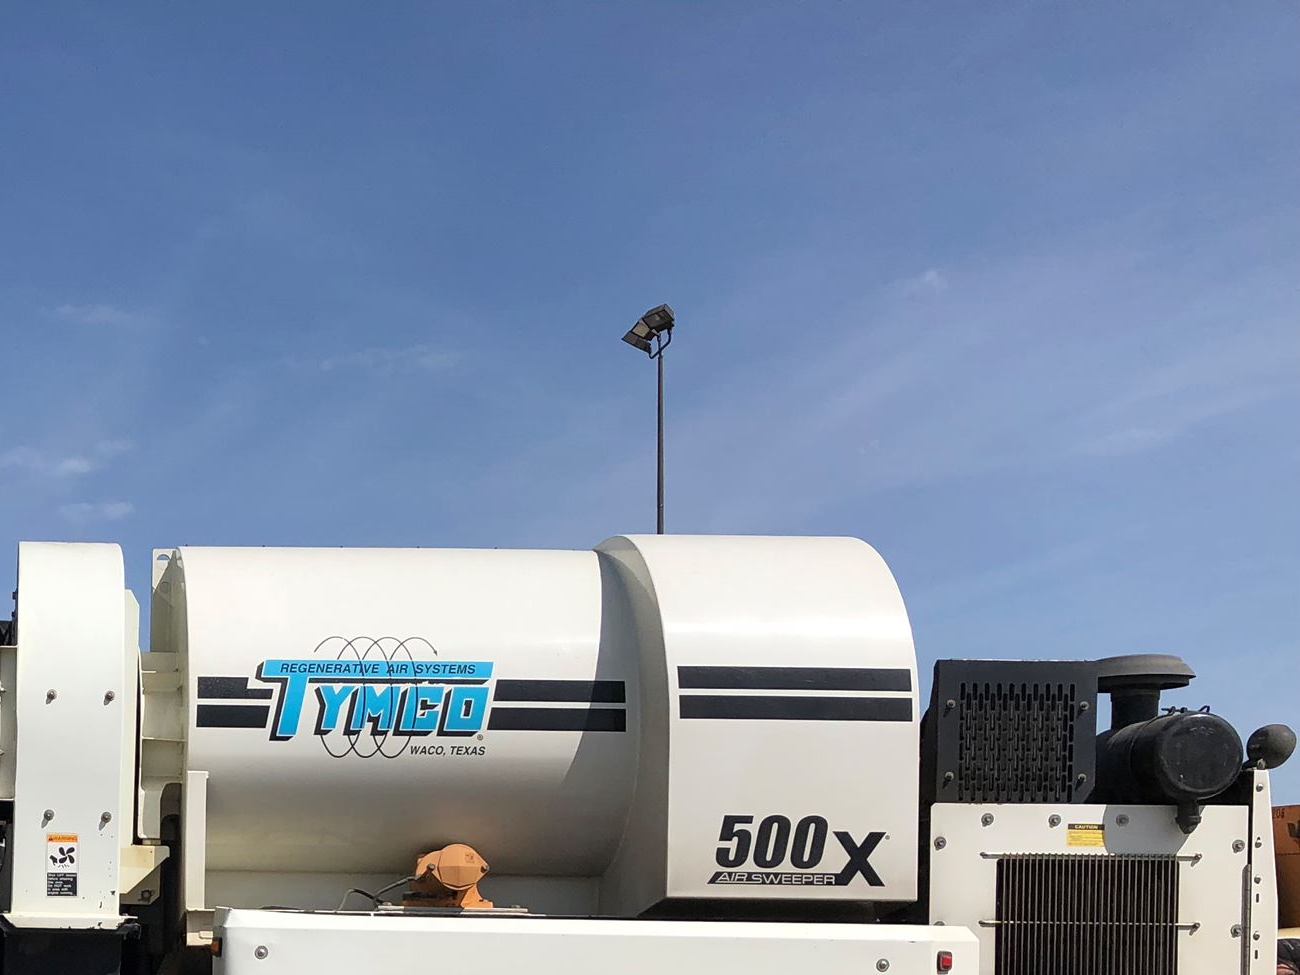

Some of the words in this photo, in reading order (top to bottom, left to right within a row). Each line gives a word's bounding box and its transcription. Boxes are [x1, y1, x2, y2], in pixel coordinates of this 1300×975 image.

[280, 663, 380, 675] REGENERATIVE
[386, 664, 408, 675] AIR
[415, 664, 477, 675] SYSTEMS
[255, 660, 494, 741] TYMCO
[409, 745, 446, 757] WACO,
[449, 746, 486, 757] TEXAS
[715, 871, 748, 883] AIR
[751, 874, 836, 885] SWEEPER
